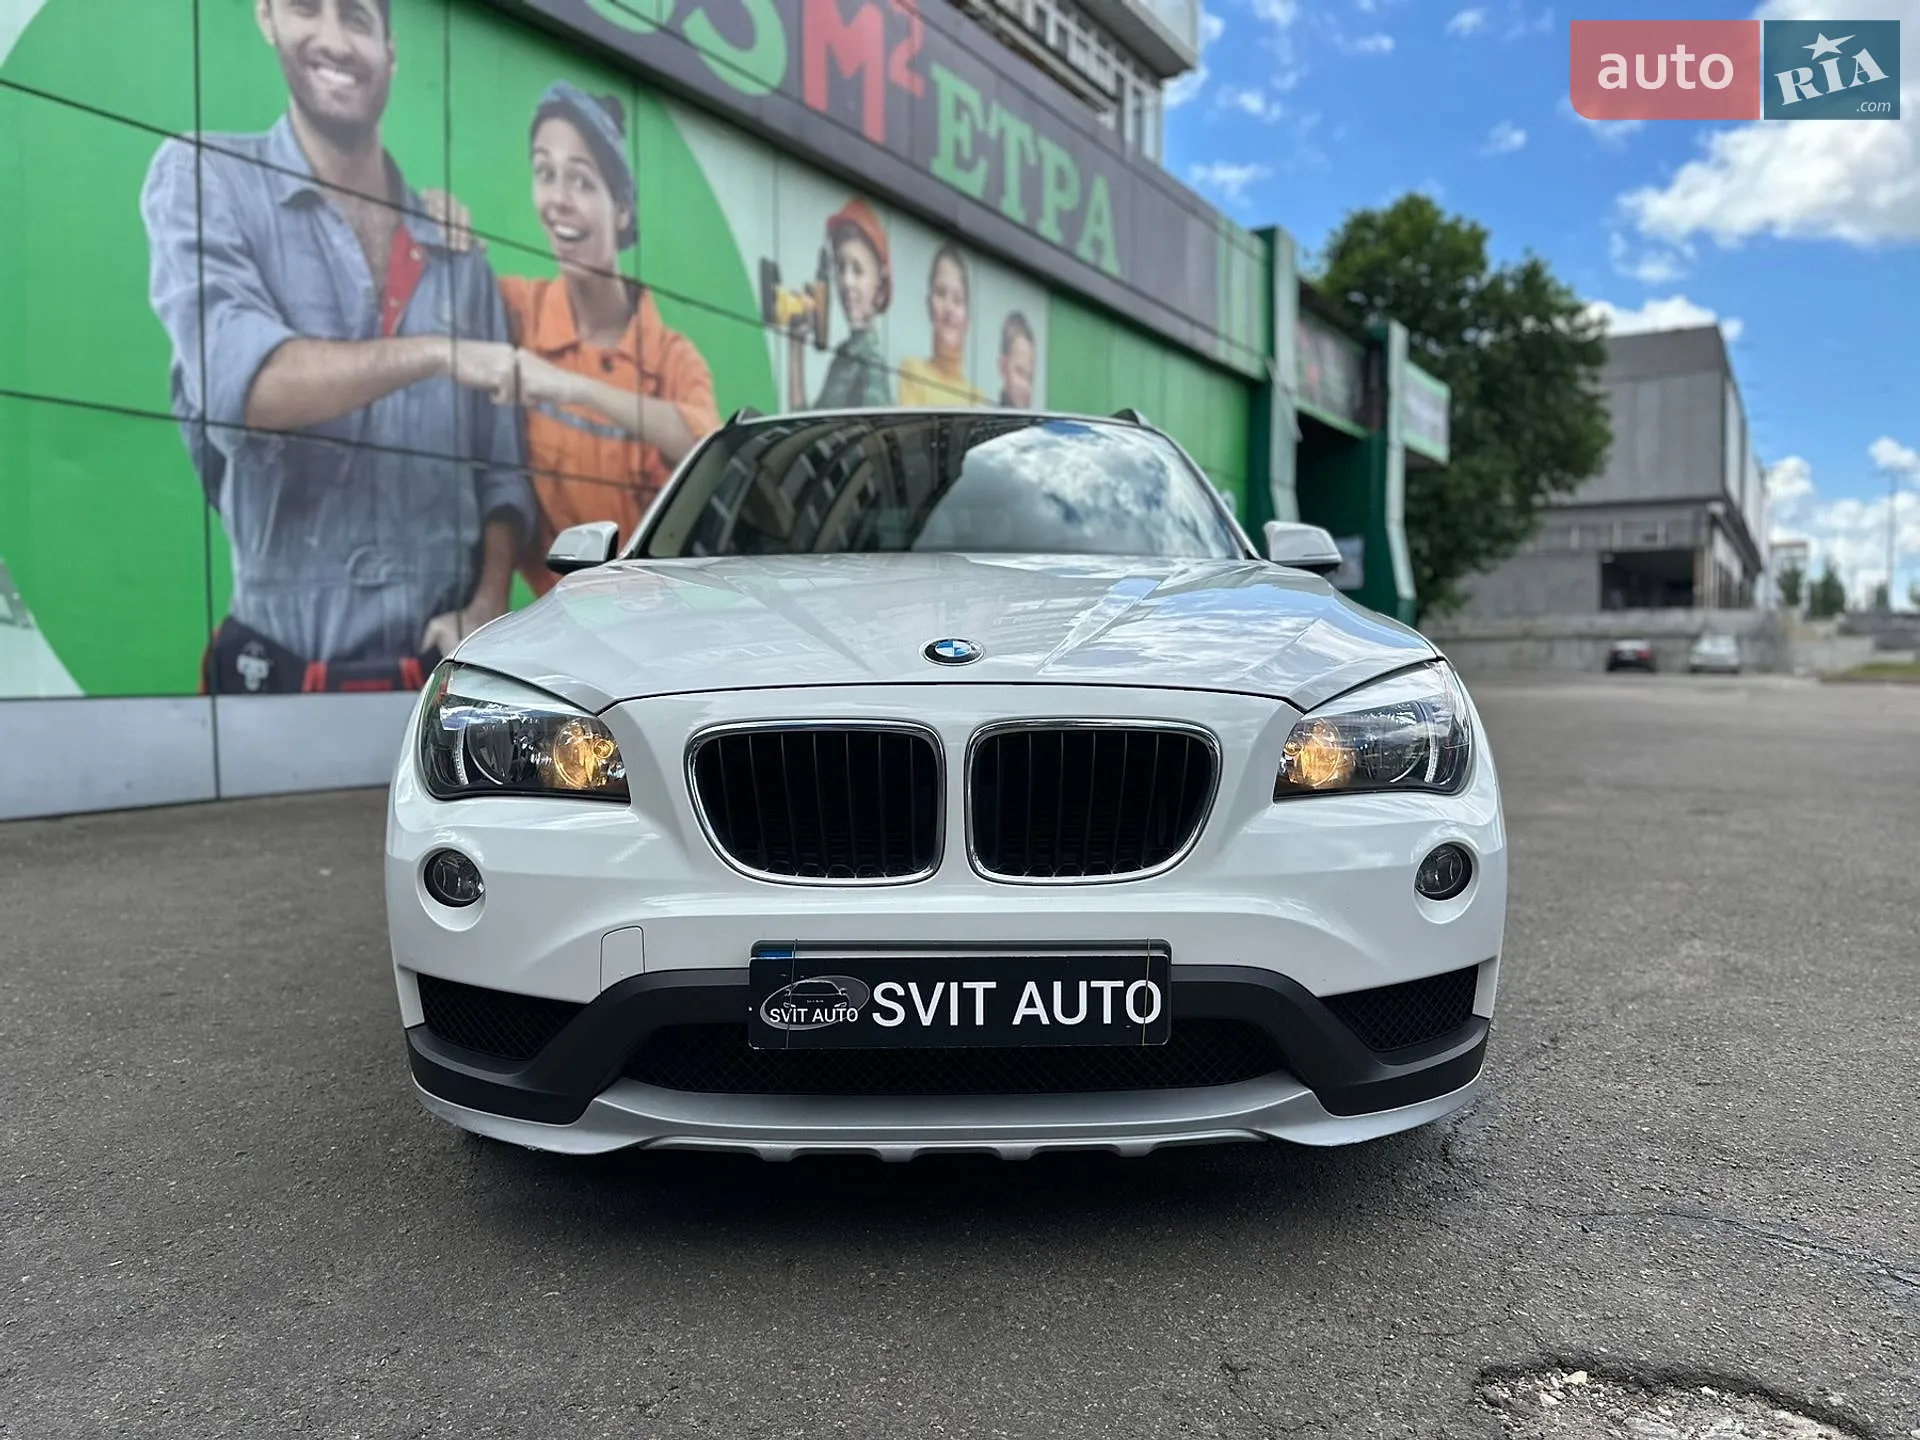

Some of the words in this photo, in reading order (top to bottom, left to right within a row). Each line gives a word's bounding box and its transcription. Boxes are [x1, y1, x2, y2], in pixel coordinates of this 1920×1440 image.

[769, 1007, 809, 1023] SVIT
[812, 1007, 859, 1023] AUTO
[872, 980, 997, 1027] SVIT
[1011, 979, 1161, 1026] AUTO
